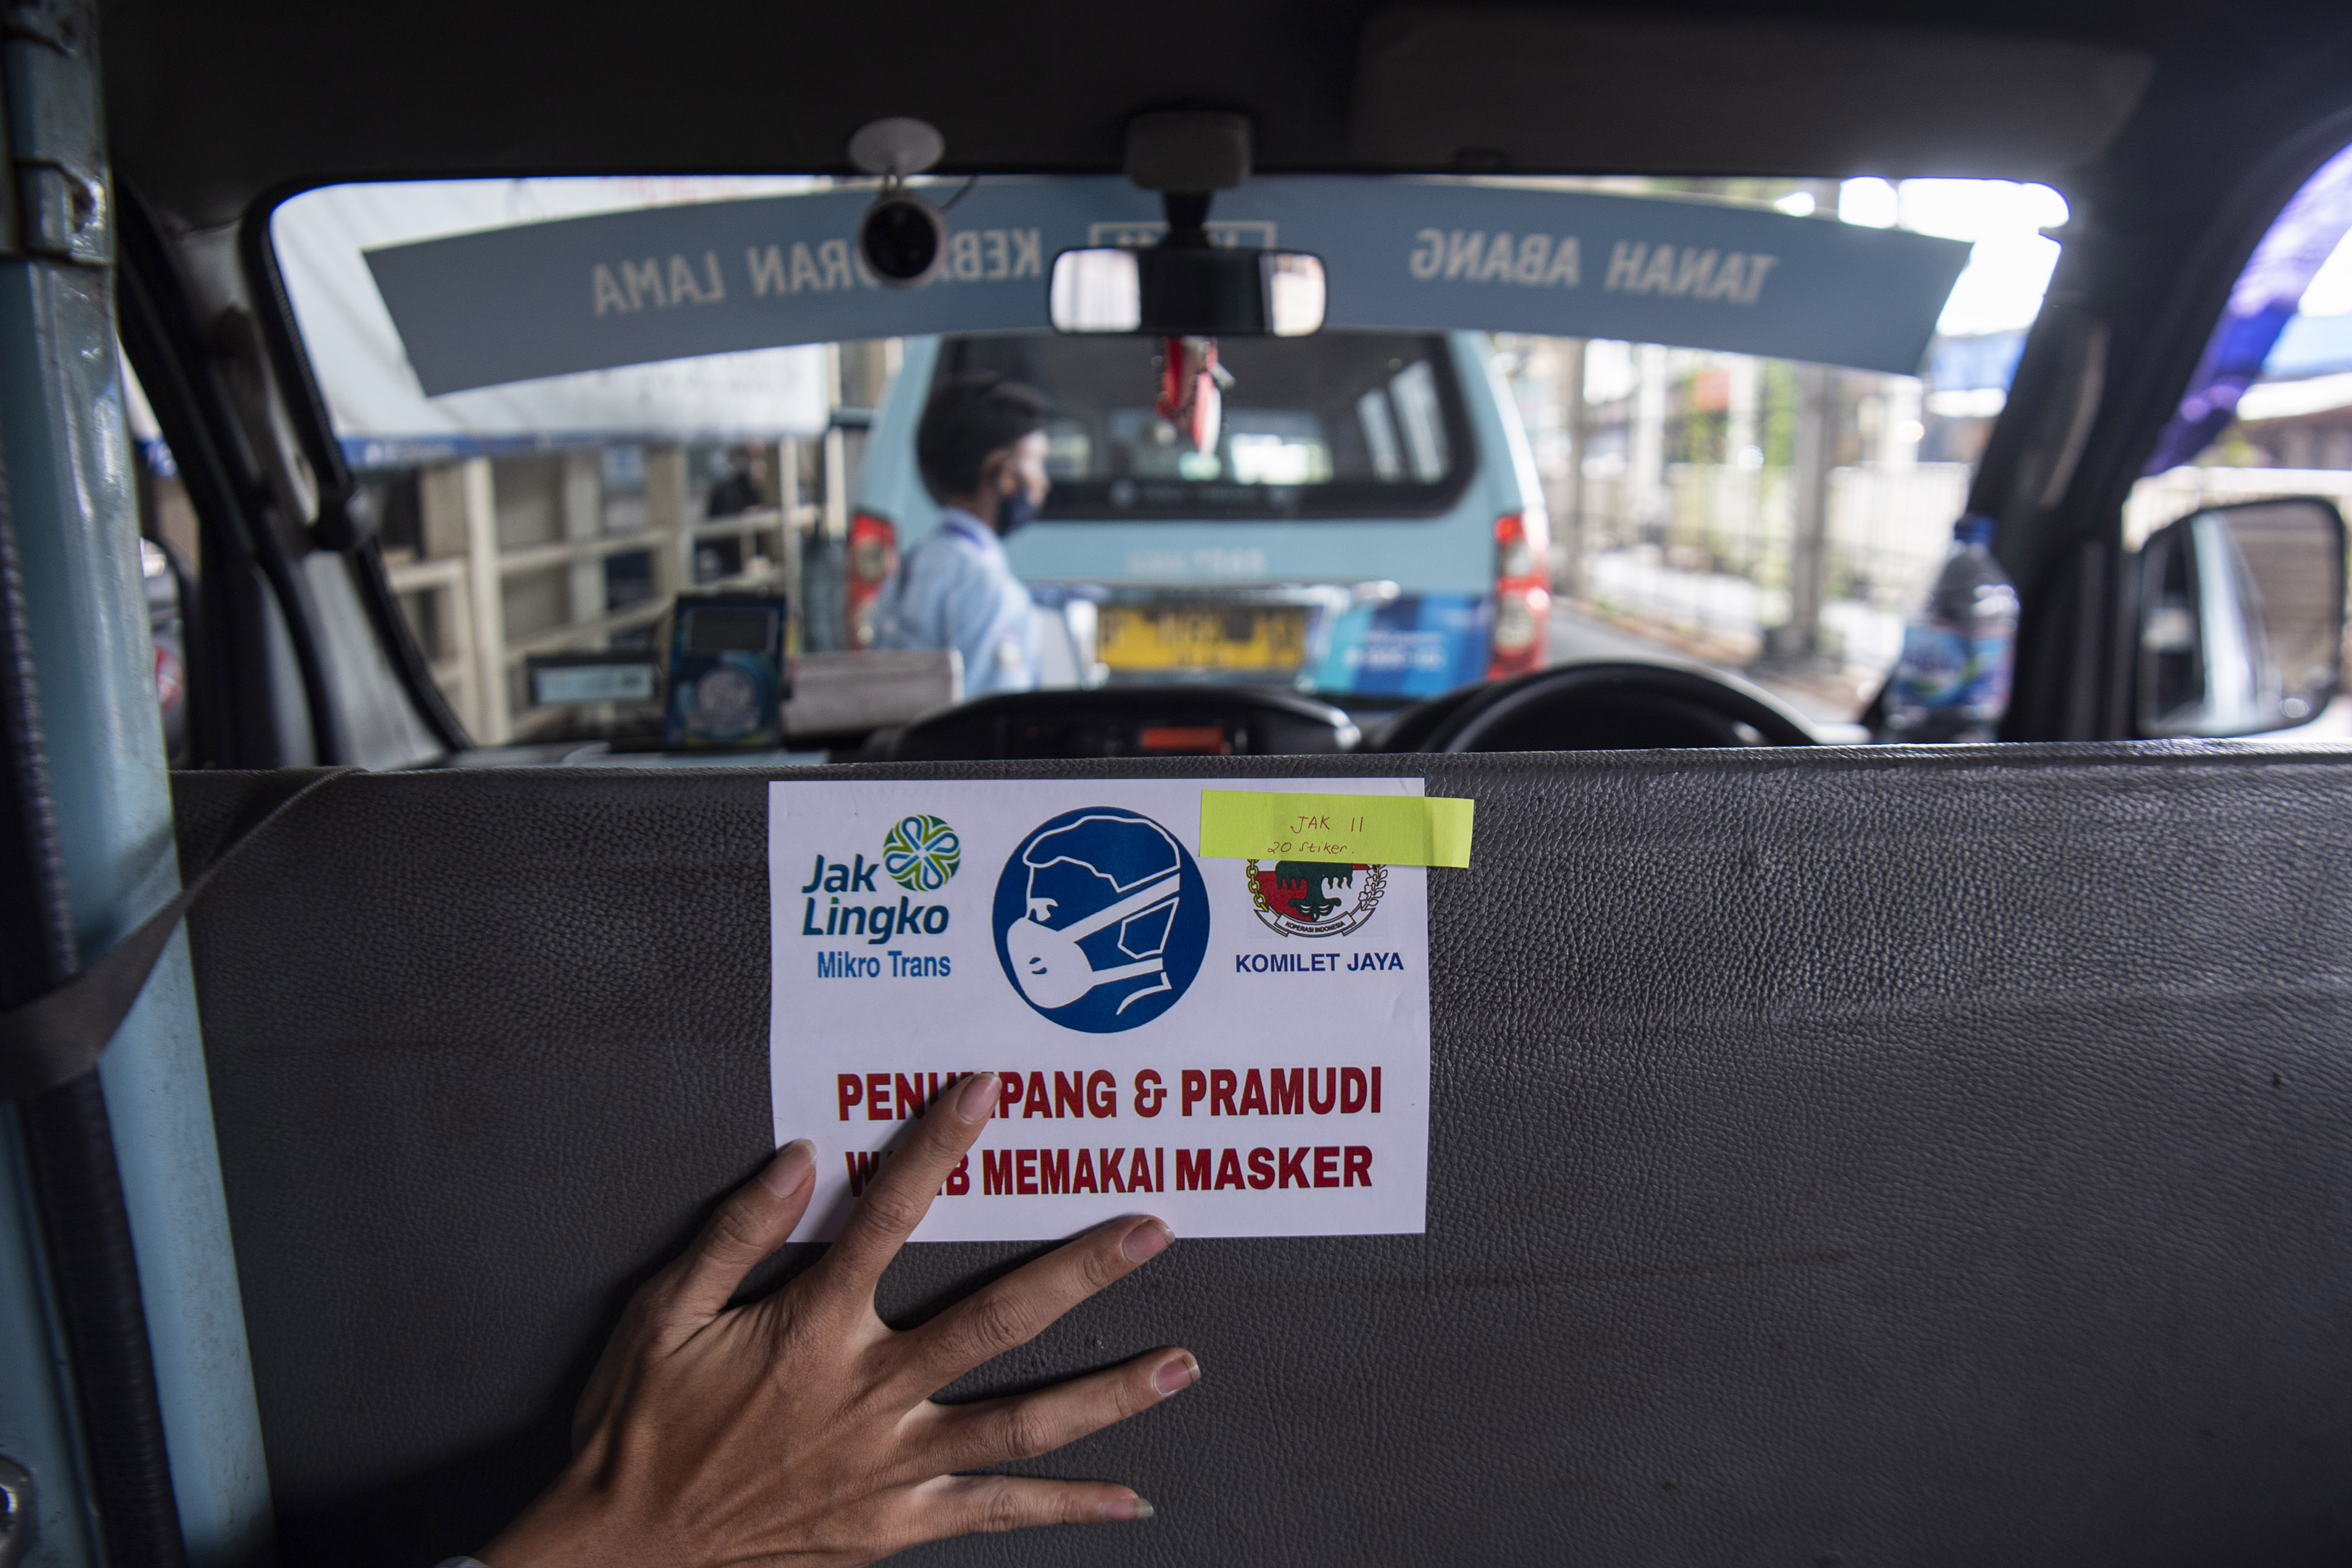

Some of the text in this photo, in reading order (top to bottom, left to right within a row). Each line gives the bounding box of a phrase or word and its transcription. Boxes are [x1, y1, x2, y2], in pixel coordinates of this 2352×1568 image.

[1290, 815, 1331, 834] JAK
[1268, 841, 1292, 854] 20
[801, 854, 880, 894] Jak
[801, 895, 950, 945] Lingko
[1285, 921, 1345, 932] KOPERASI INDONESIA
[817, 950, 951, 978] Mikro Trans
[1235, 952, 1404, 973] KOMILET JAYA
[1134, 1068, 1167, 1118] &
[1181, 1066, 1381, 1116] PRAMUDI
[982, 1147, 1165, 1196] MEMAKAI
[1175, 1145, 1373, 1191] MASKER
